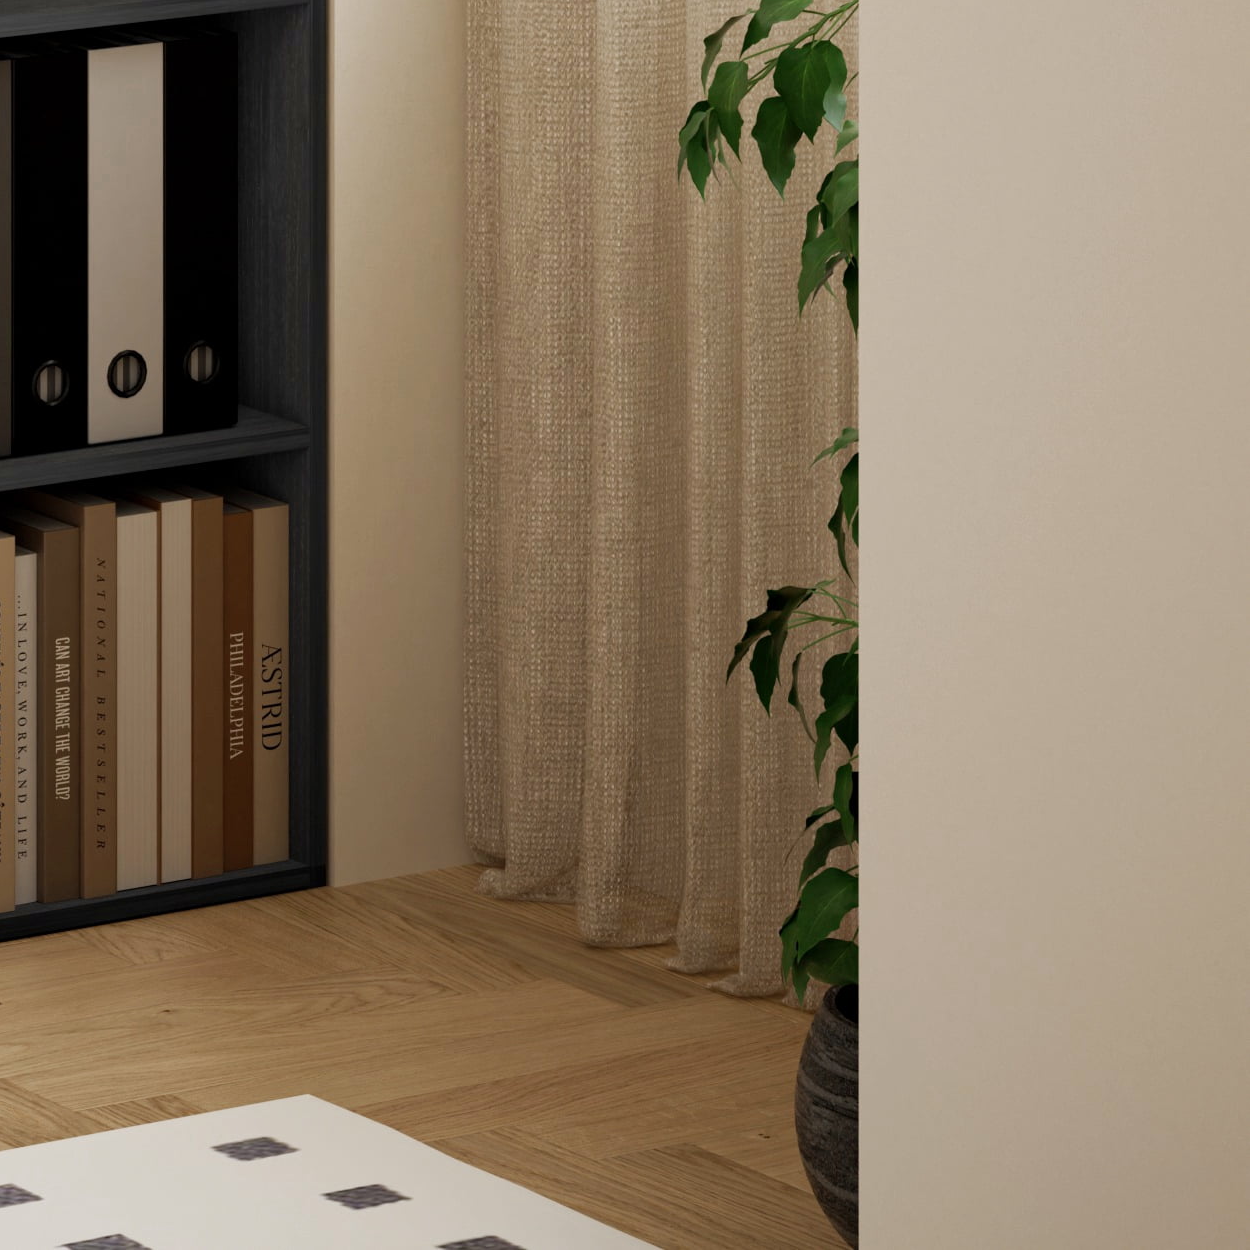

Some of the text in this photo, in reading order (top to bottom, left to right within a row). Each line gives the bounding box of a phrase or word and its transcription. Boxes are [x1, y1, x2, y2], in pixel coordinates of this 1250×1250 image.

[16, 639, 27, 694] LOVE,
[229, 632, 244, 760] PHILADELPHIA
[16, 700, 27, 761] WORK,
[55, 637, 70, 800] CAN ART CHANGE THE WORLD?
[96, 558, 106, 849] NATIONAL BESTSELLER
[18, 767, 27, 804] AND
[18, 816, 27, 859] LIFE
